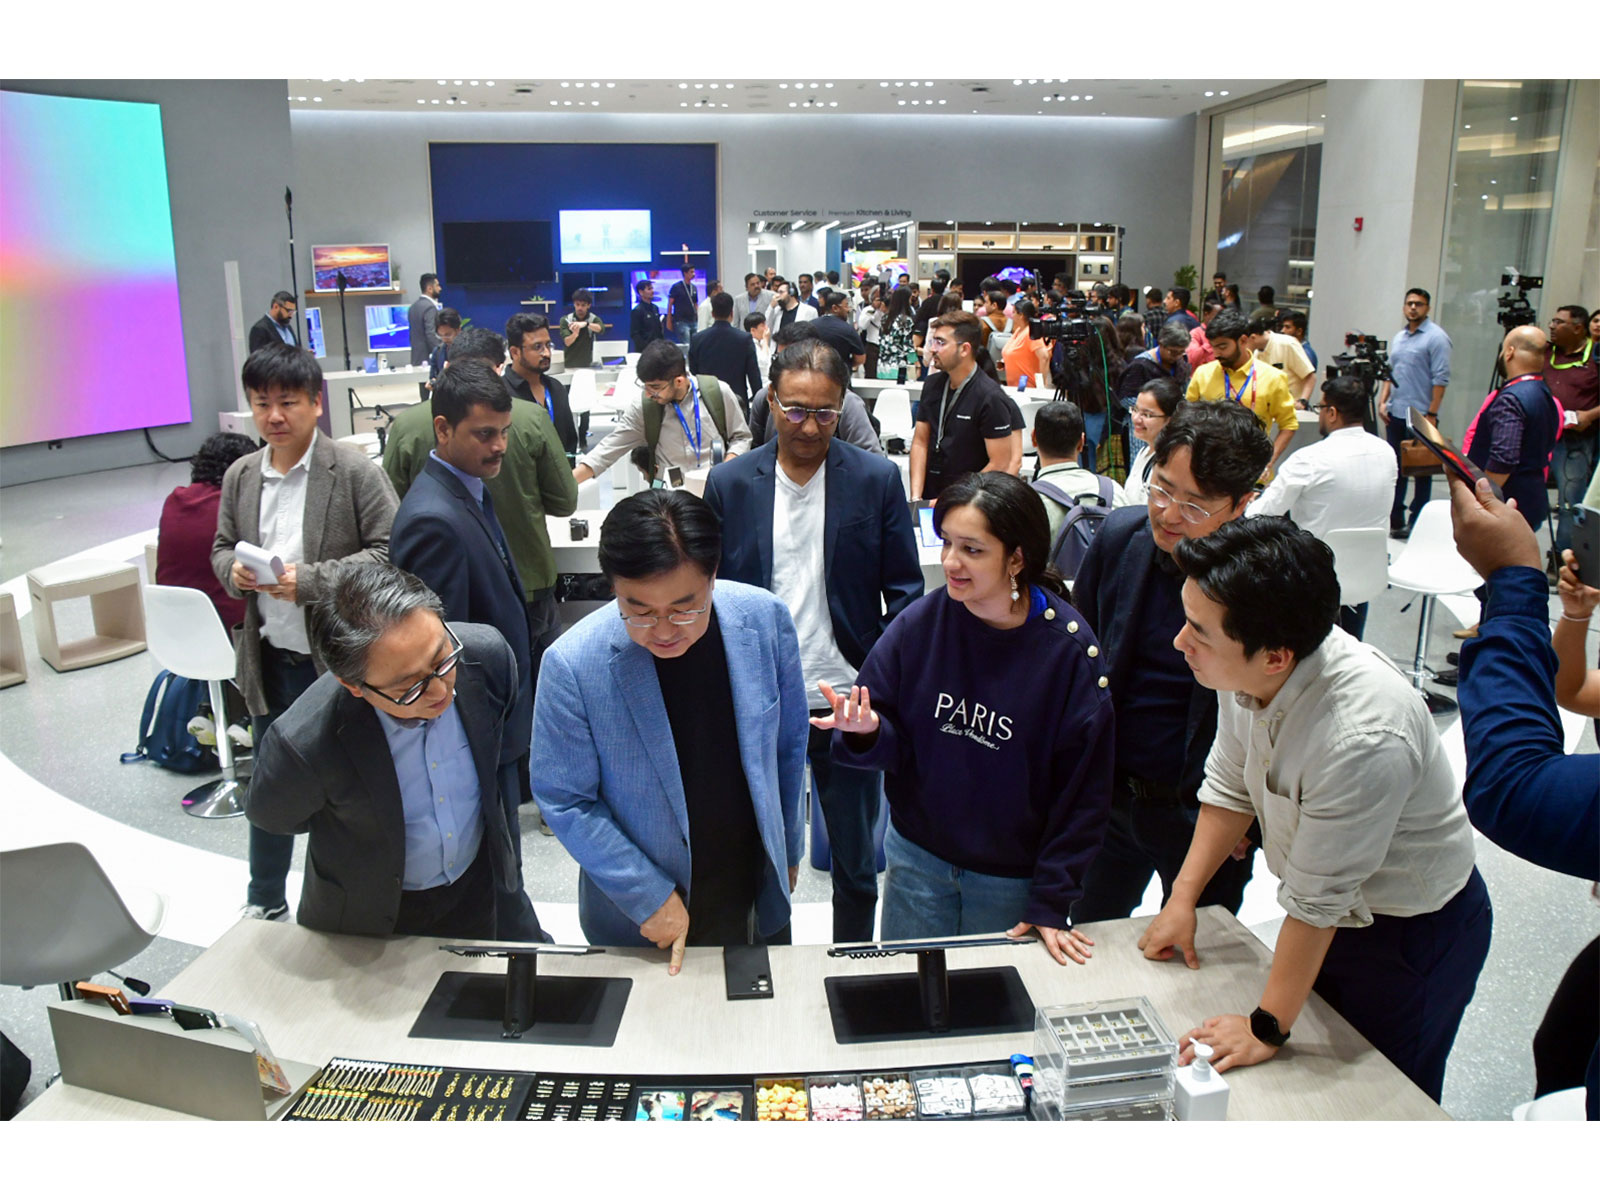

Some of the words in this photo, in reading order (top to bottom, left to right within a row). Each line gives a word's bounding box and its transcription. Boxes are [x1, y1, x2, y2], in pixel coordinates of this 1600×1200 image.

[753, 209, 788, 217] Customer
[790, 209, 818, 217] Service
[856, 209, 883, 217] Kitchen
[884, 209, 890, 217] &
[891, 209, 912, 219] Living
[934, 692, 1013, 740] PARIS
